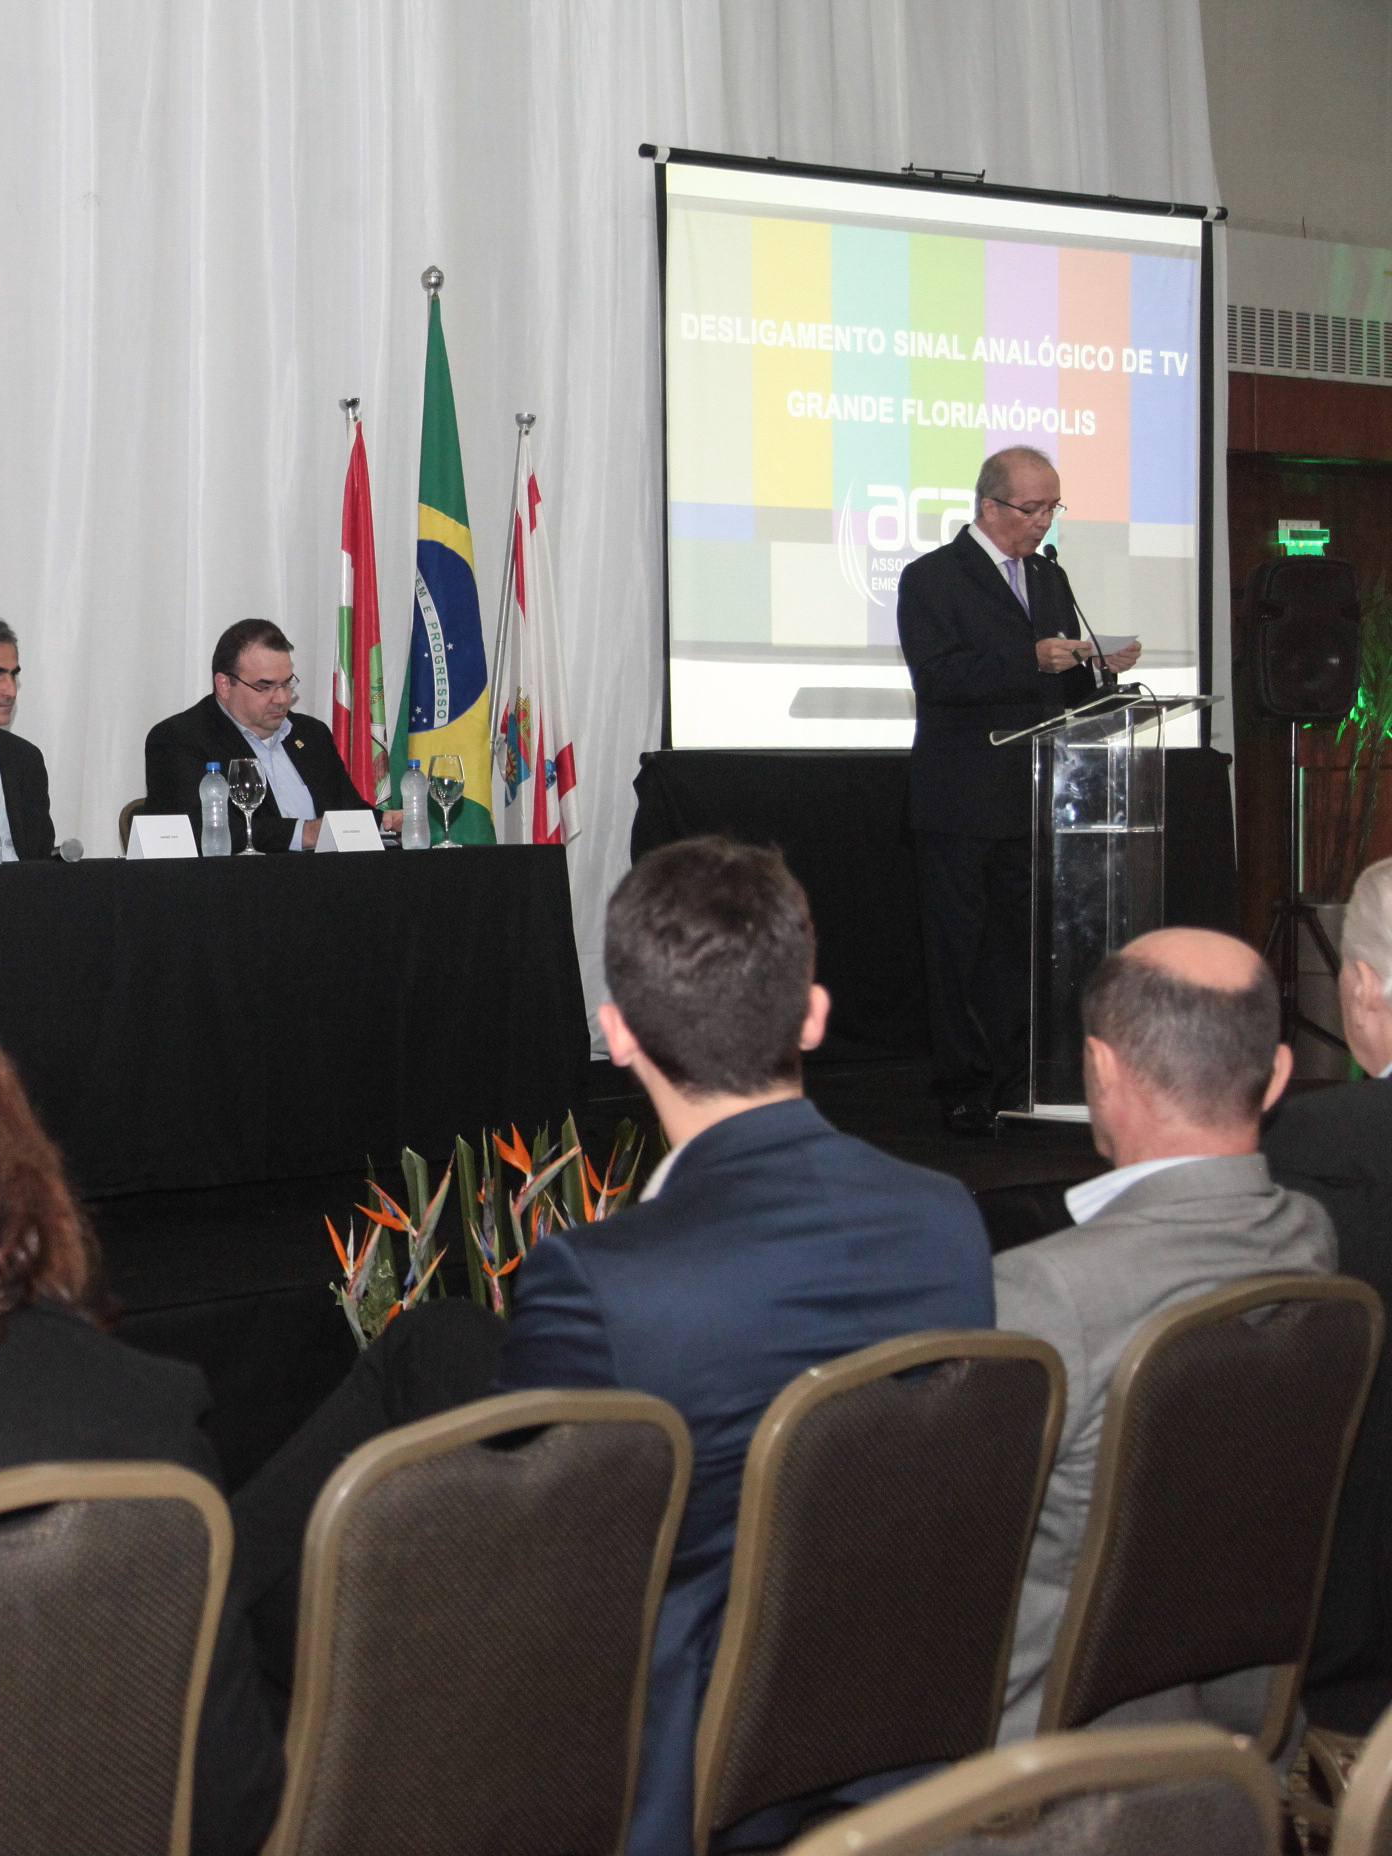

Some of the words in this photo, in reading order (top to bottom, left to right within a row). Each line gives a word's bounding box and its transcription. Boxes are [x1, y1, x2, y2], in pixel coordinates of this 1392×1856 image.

[680, 312, 886, 355] DESLIGAMENTO
[893, 329, 966, 361] SINAL
[972, 335, 1115, 372] ANALÓGICO
[1121, 347, 1153, 375] DE
[1159, 350, 1188, 377] TV
[786, 390, 894, 423] GRANDE
[902, 397, 1096, 436] FLORIANÓPOLIS
[867, 484, 975, 553] aca
[428, 621, 447, 719] PROGRESSO
